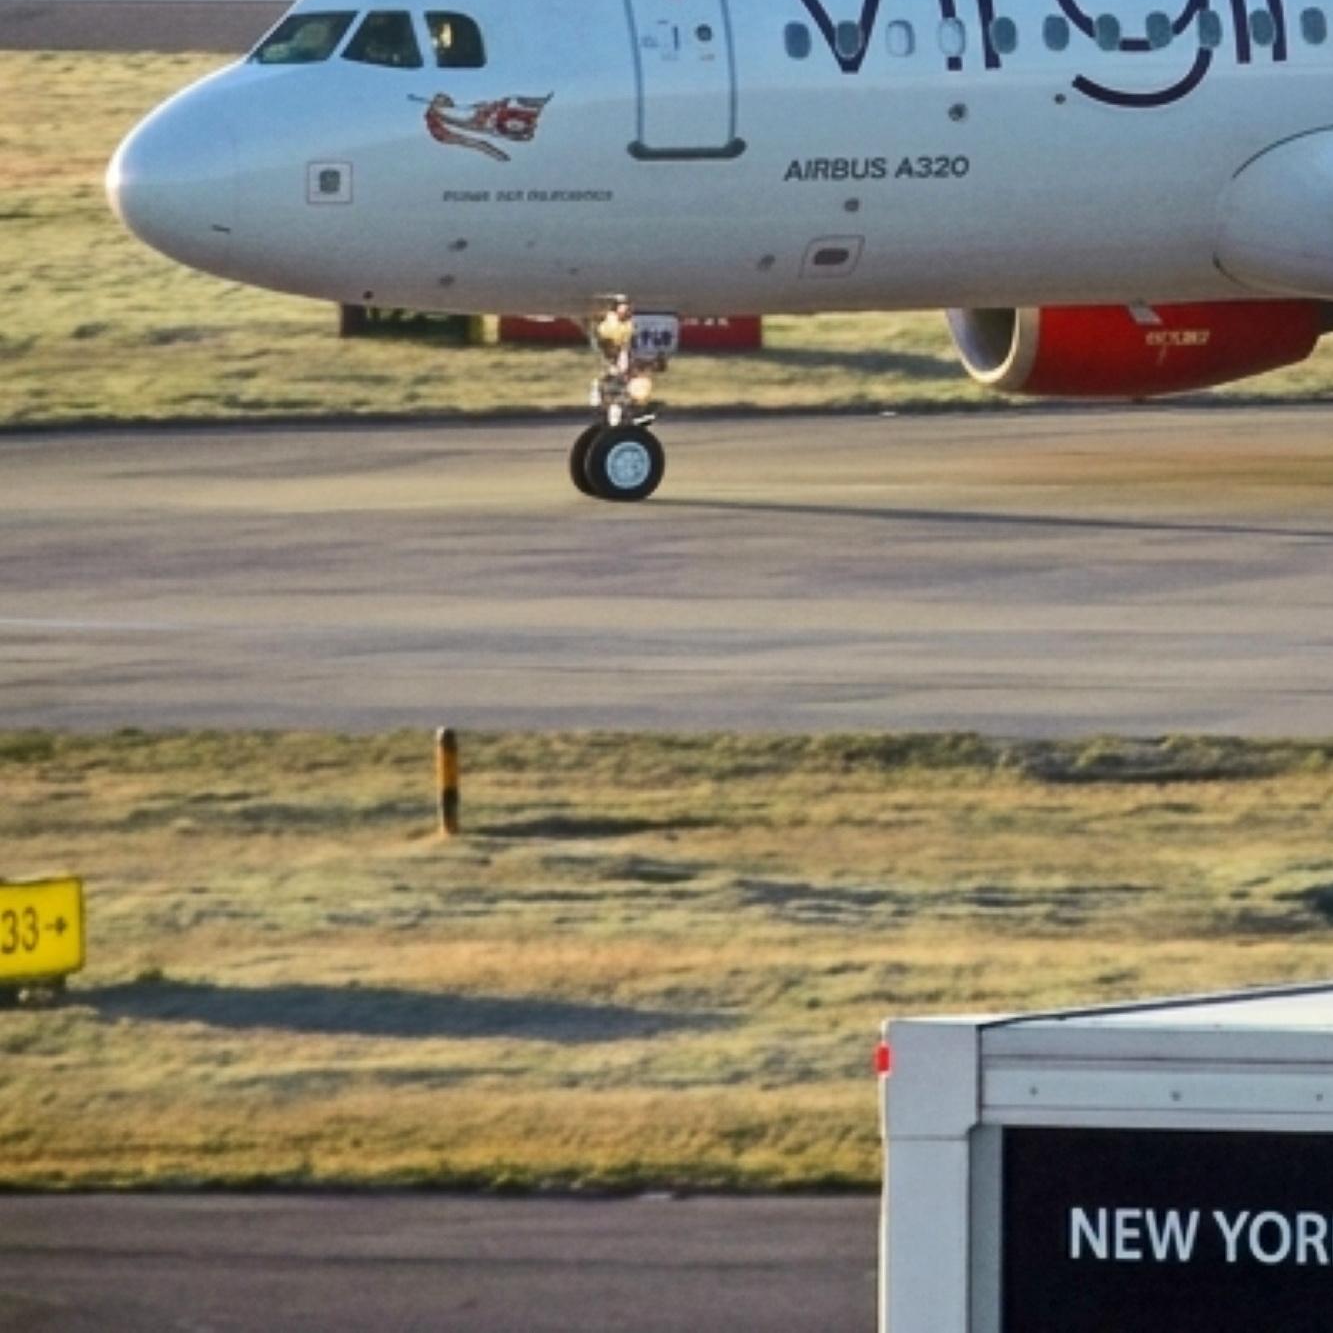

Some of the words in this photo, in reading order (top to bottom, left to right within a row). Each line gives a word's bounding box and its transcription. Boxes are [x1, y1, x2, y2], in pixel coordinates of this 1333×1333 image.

[784, 157, 887, 182] AIRBUS
[895, 155, 970, 179] A320
[1069, 1207, 1199, 1261] NEW
